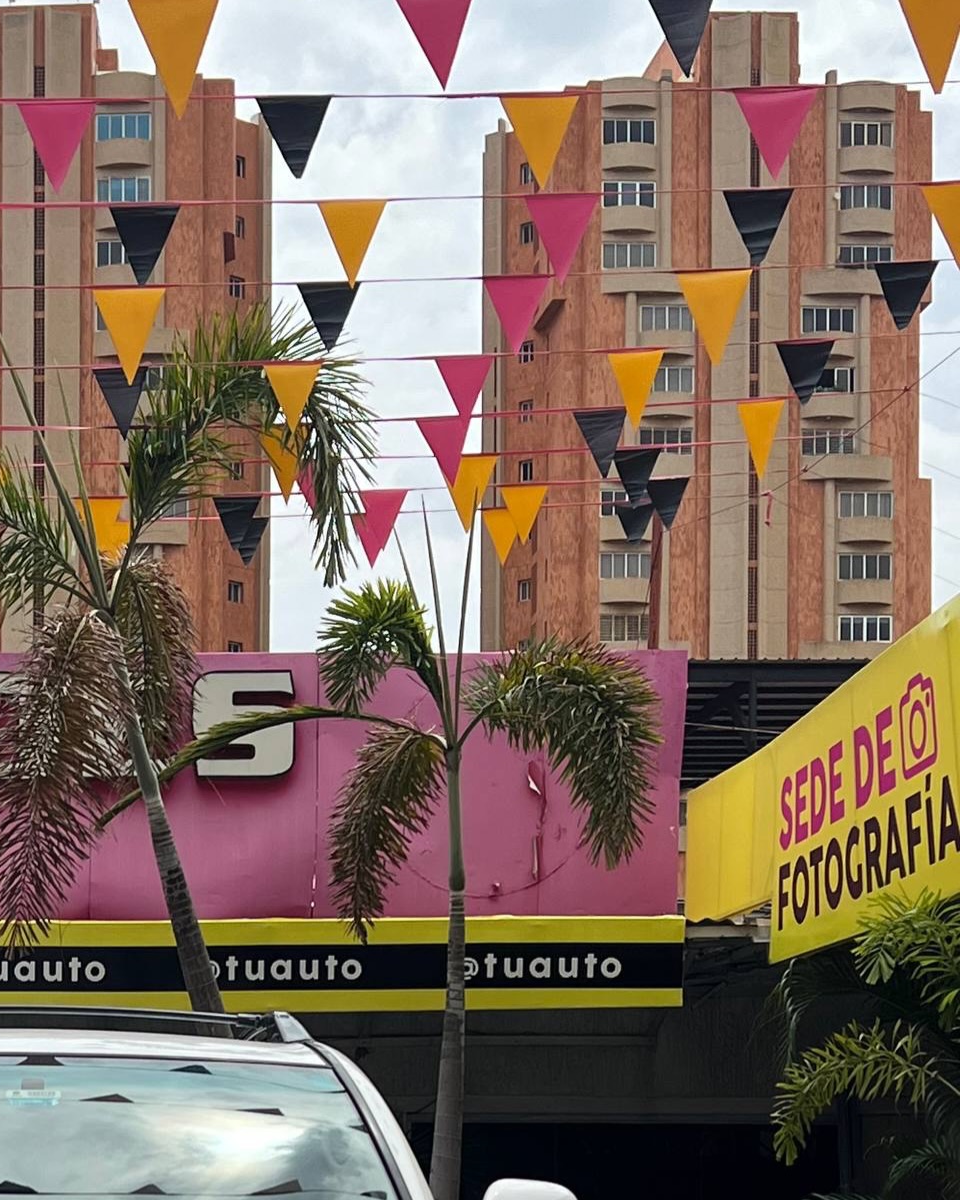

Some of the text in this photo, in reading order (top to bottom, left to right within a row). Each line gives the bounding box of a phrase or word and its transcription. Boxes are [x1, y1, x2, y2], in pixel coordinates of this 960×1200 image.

[777, 772, 960, 931] FOTOGRAFÍA
[779, 705, 896, 851] SEDE DE
